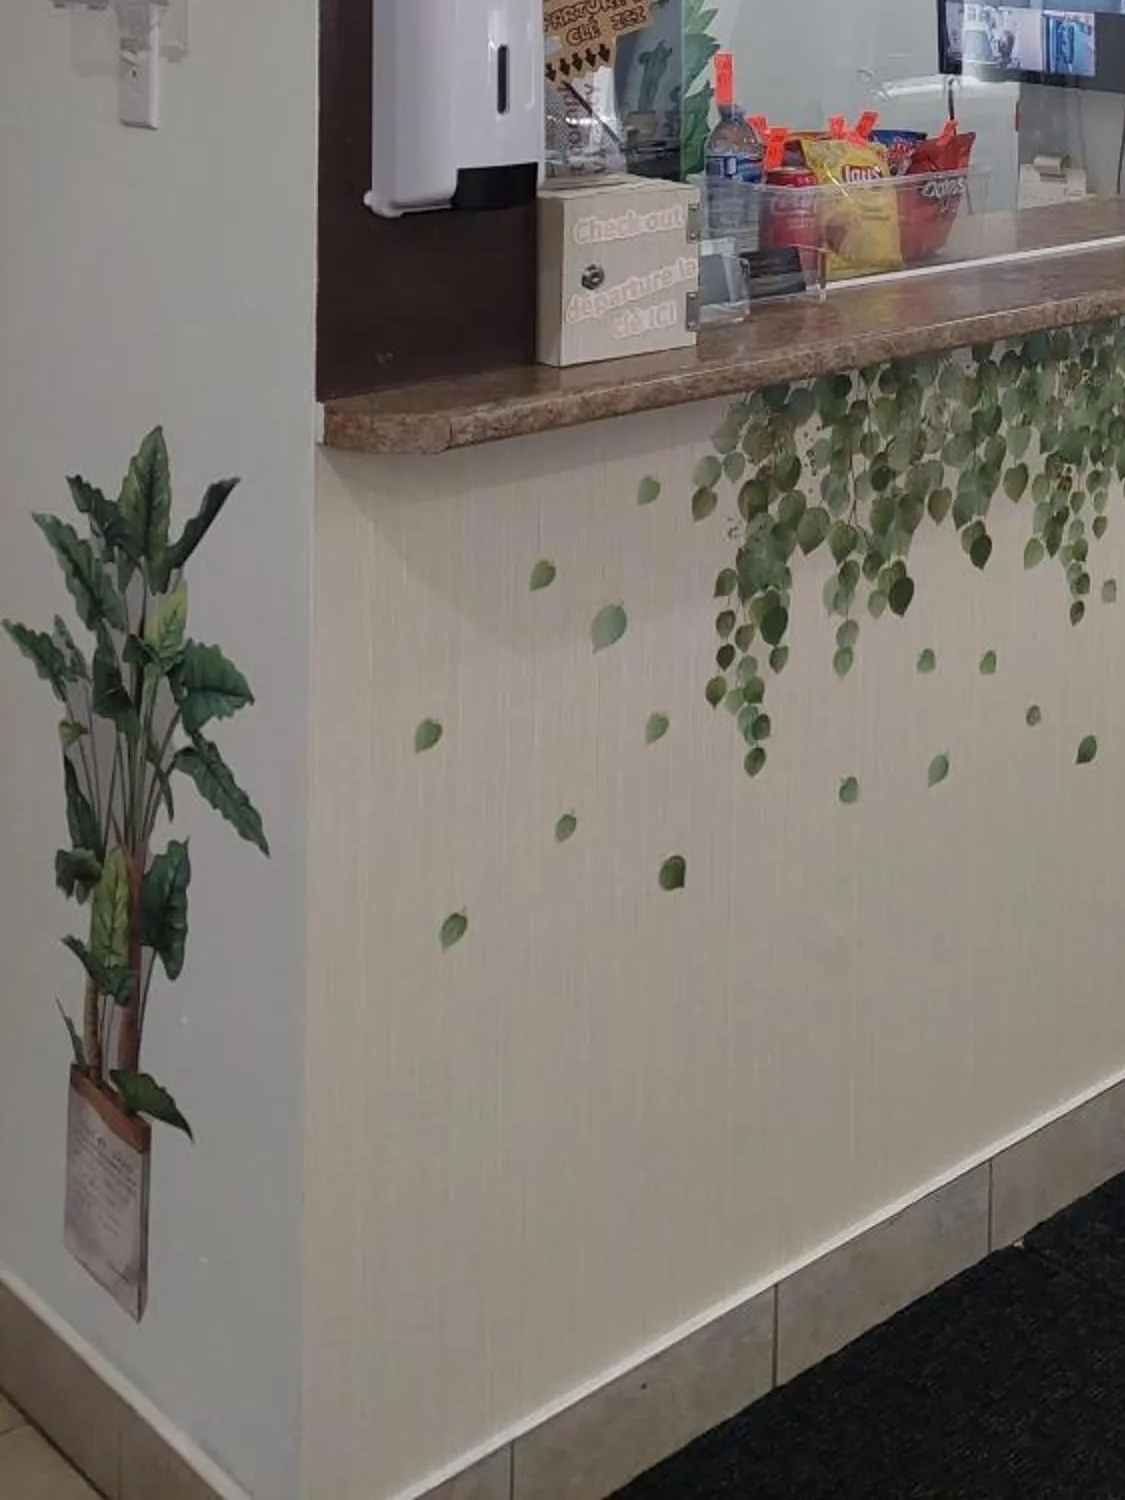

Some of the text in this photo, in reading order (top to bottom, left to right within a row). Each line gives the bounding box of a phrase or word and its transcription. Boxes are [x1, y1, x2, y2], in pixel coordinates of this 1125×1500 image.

[574, 206, 684, 243] Check out
[676, 256, 698, 281] la
